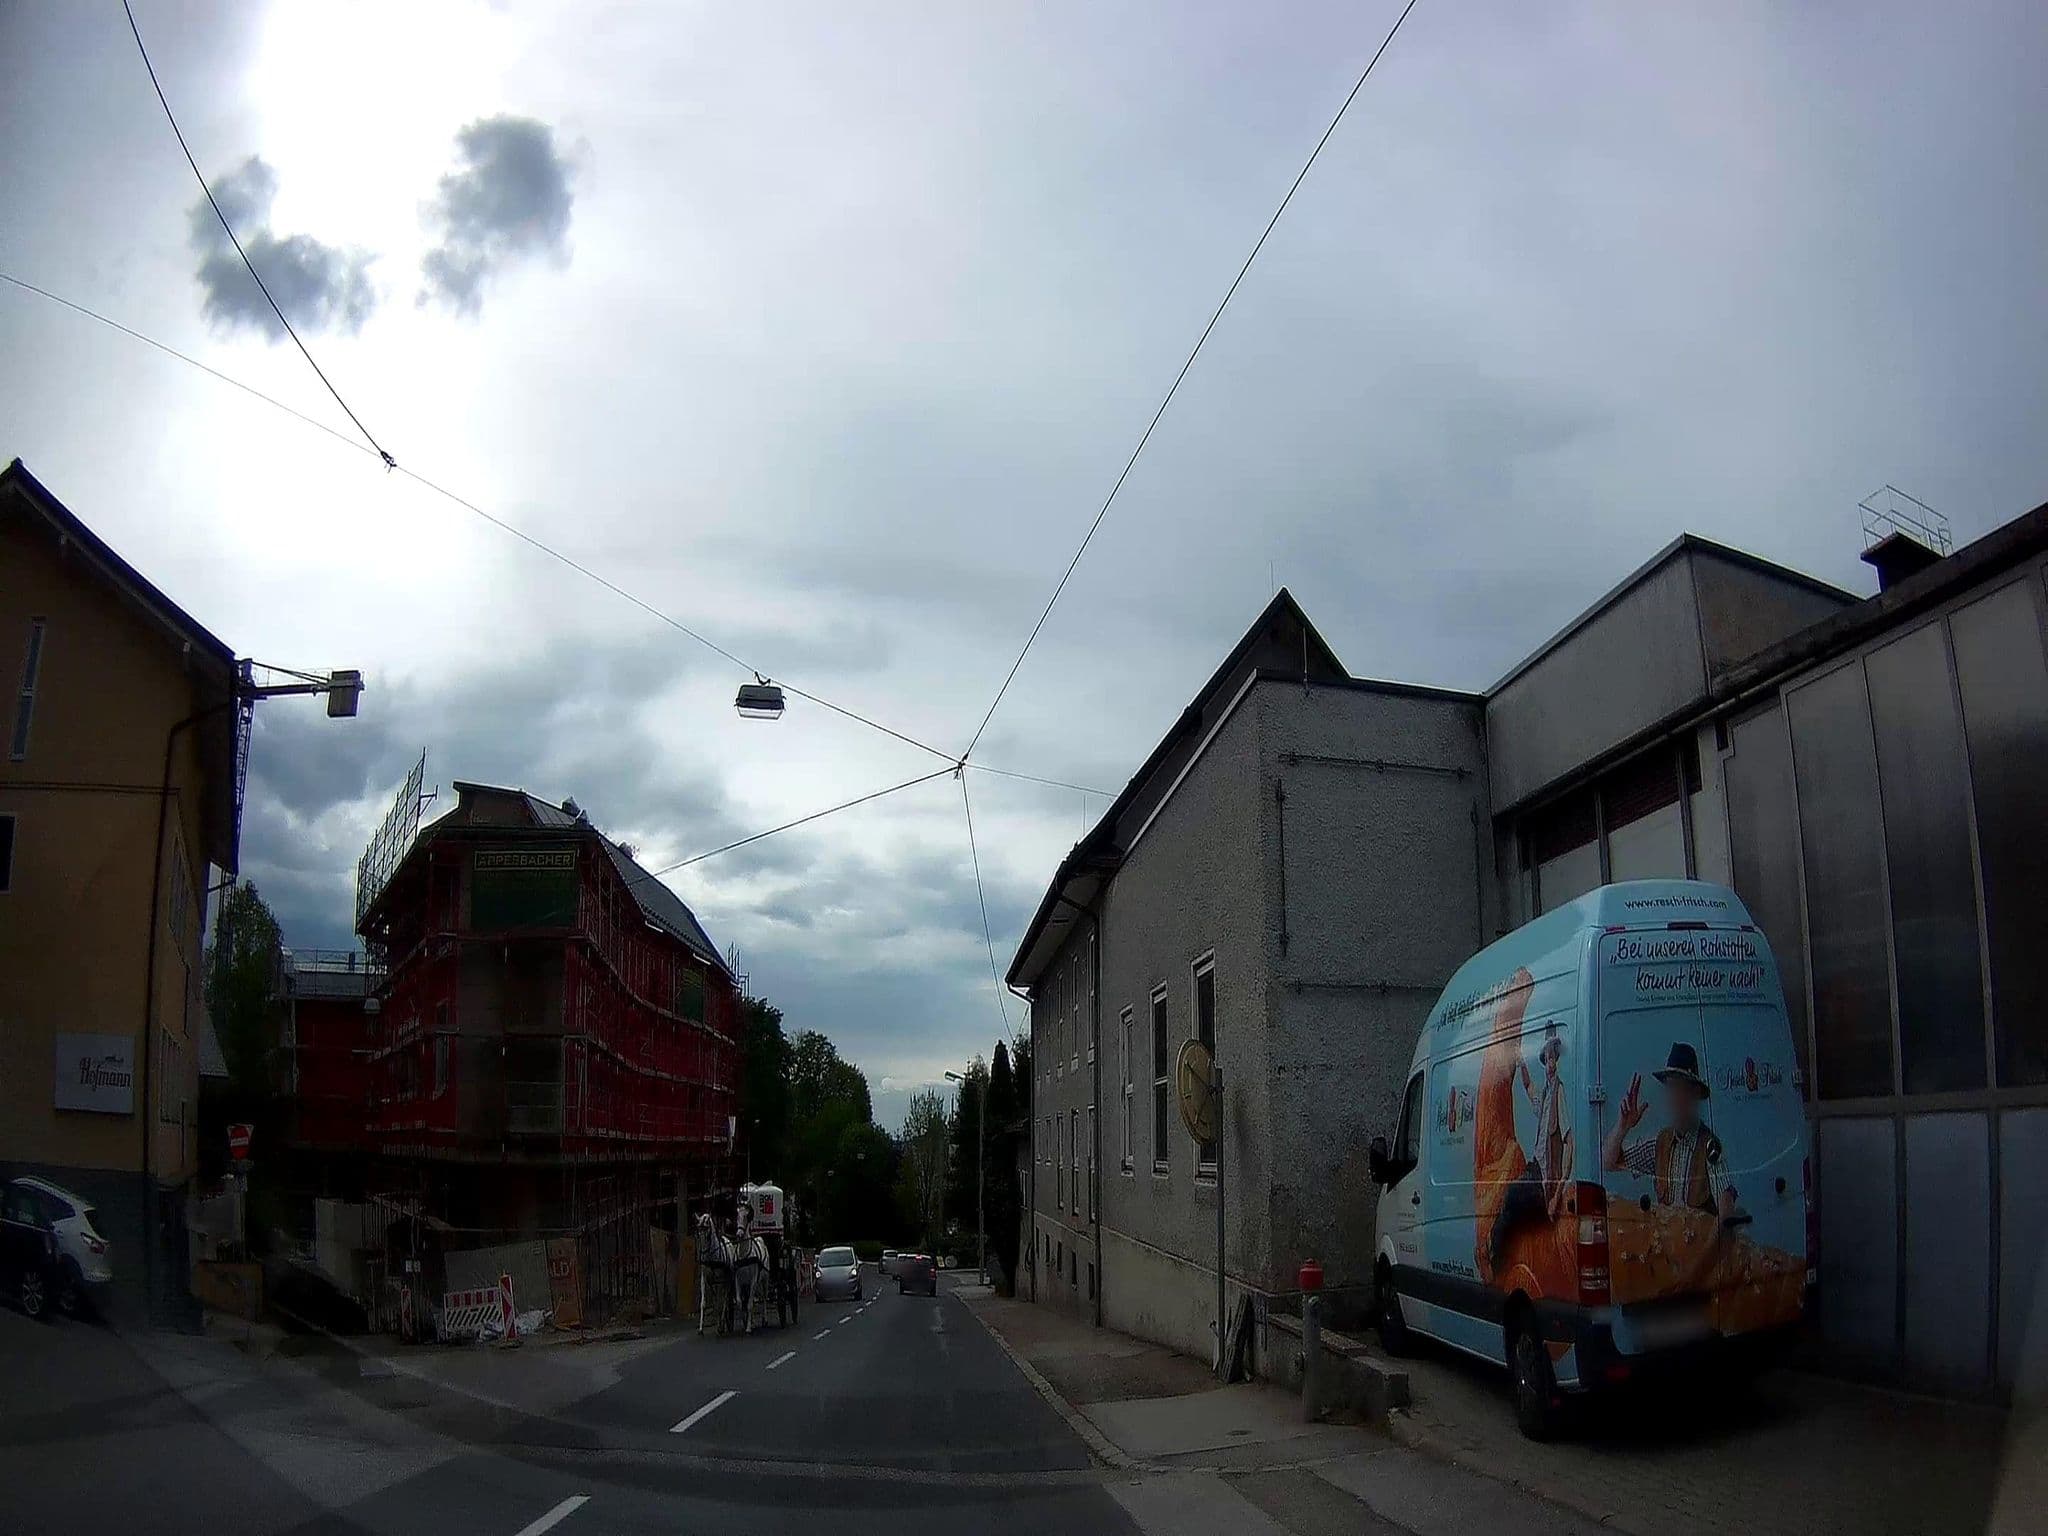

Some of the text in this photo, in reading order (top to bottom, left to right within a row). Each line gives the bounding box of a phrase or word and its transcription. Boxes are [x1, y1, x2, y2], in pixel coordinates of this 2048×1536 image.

[1646, 939, 1696, 960] unseren
[1699, 934, 1757, 962] Rohstoffen
[1635, 966, 1685, 991] kommt
[1687, 963, 1726, 989] keiner
[80, 1056, 132, 1091] Hofmann
